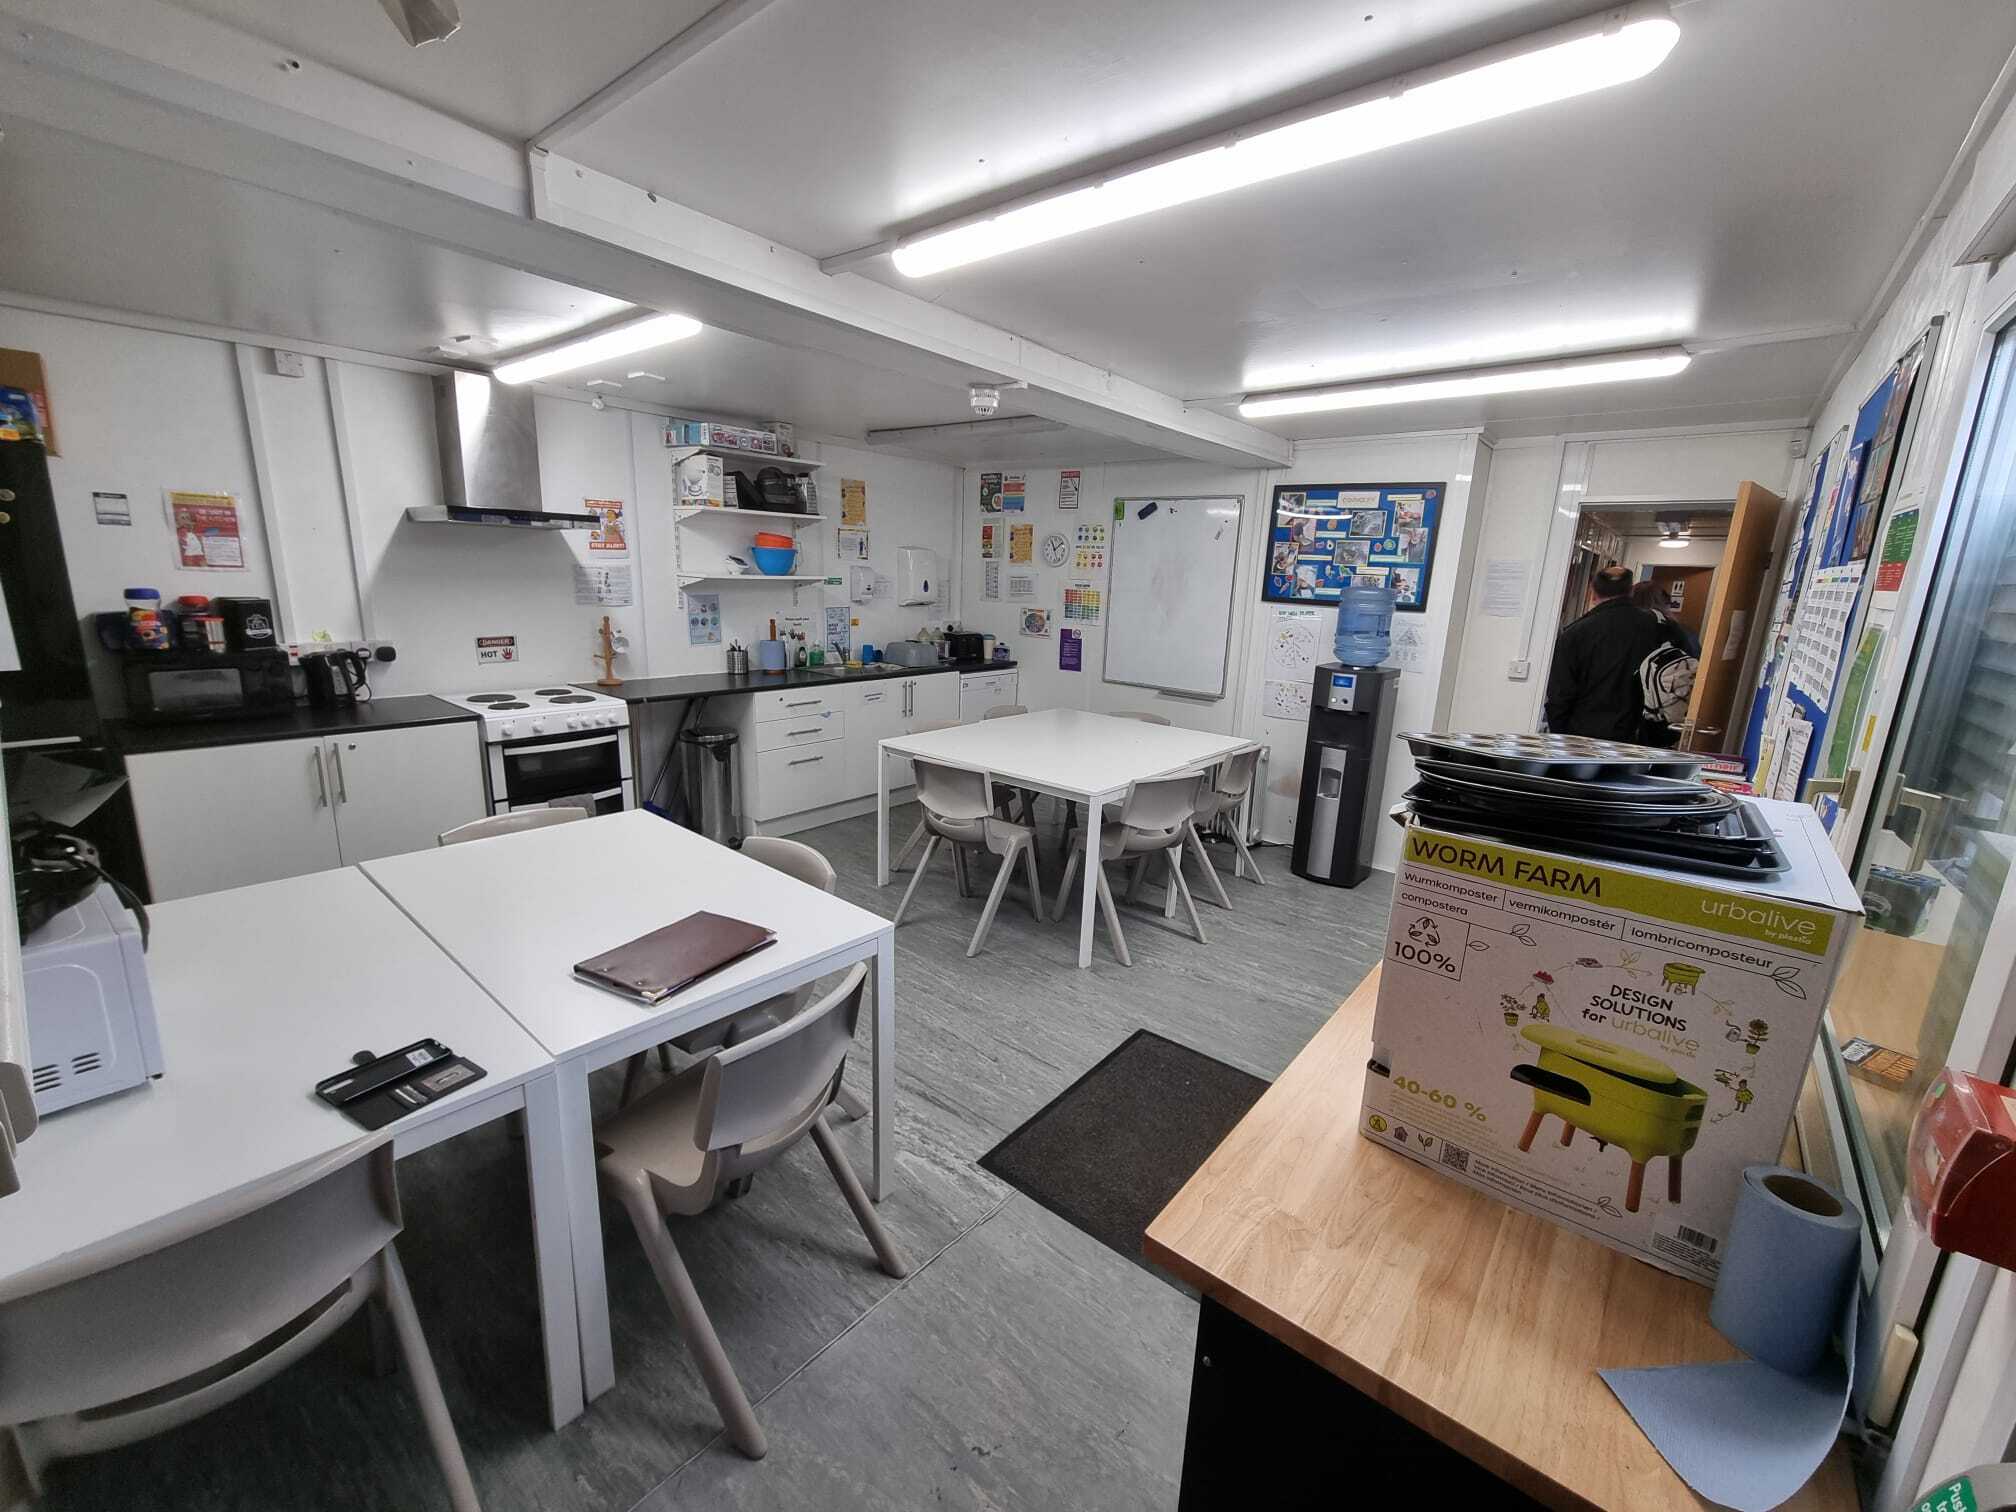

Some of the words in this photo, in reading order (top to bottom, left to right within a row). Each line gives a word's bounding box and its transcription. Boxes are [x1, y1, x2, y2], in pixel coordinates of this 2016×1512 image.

[480, 650, 497, 658] HOT
[1412, 837, 1504, 876] WORM
[1514, 860, 1601, 898] FARM
[1401, 891, 1468, 916] compostera
[1405, 871, 1498, 903] Wurmkomposter
[1631, 927, 1774, 968] lombricomposteur
[1701, 899, 1816, 936] urbalive
[1395, 941, 1455, 972] 100%
[1590, 995, 1687, 1031] SOLUTIONS
[1610, 984, 1673, 1011] DESIGN
[1581, 1008, 1607, 1023] for
[1611, 1016, 1699, 1051] urbalive
[1393, 1076, 1457, 1109] 40-60
